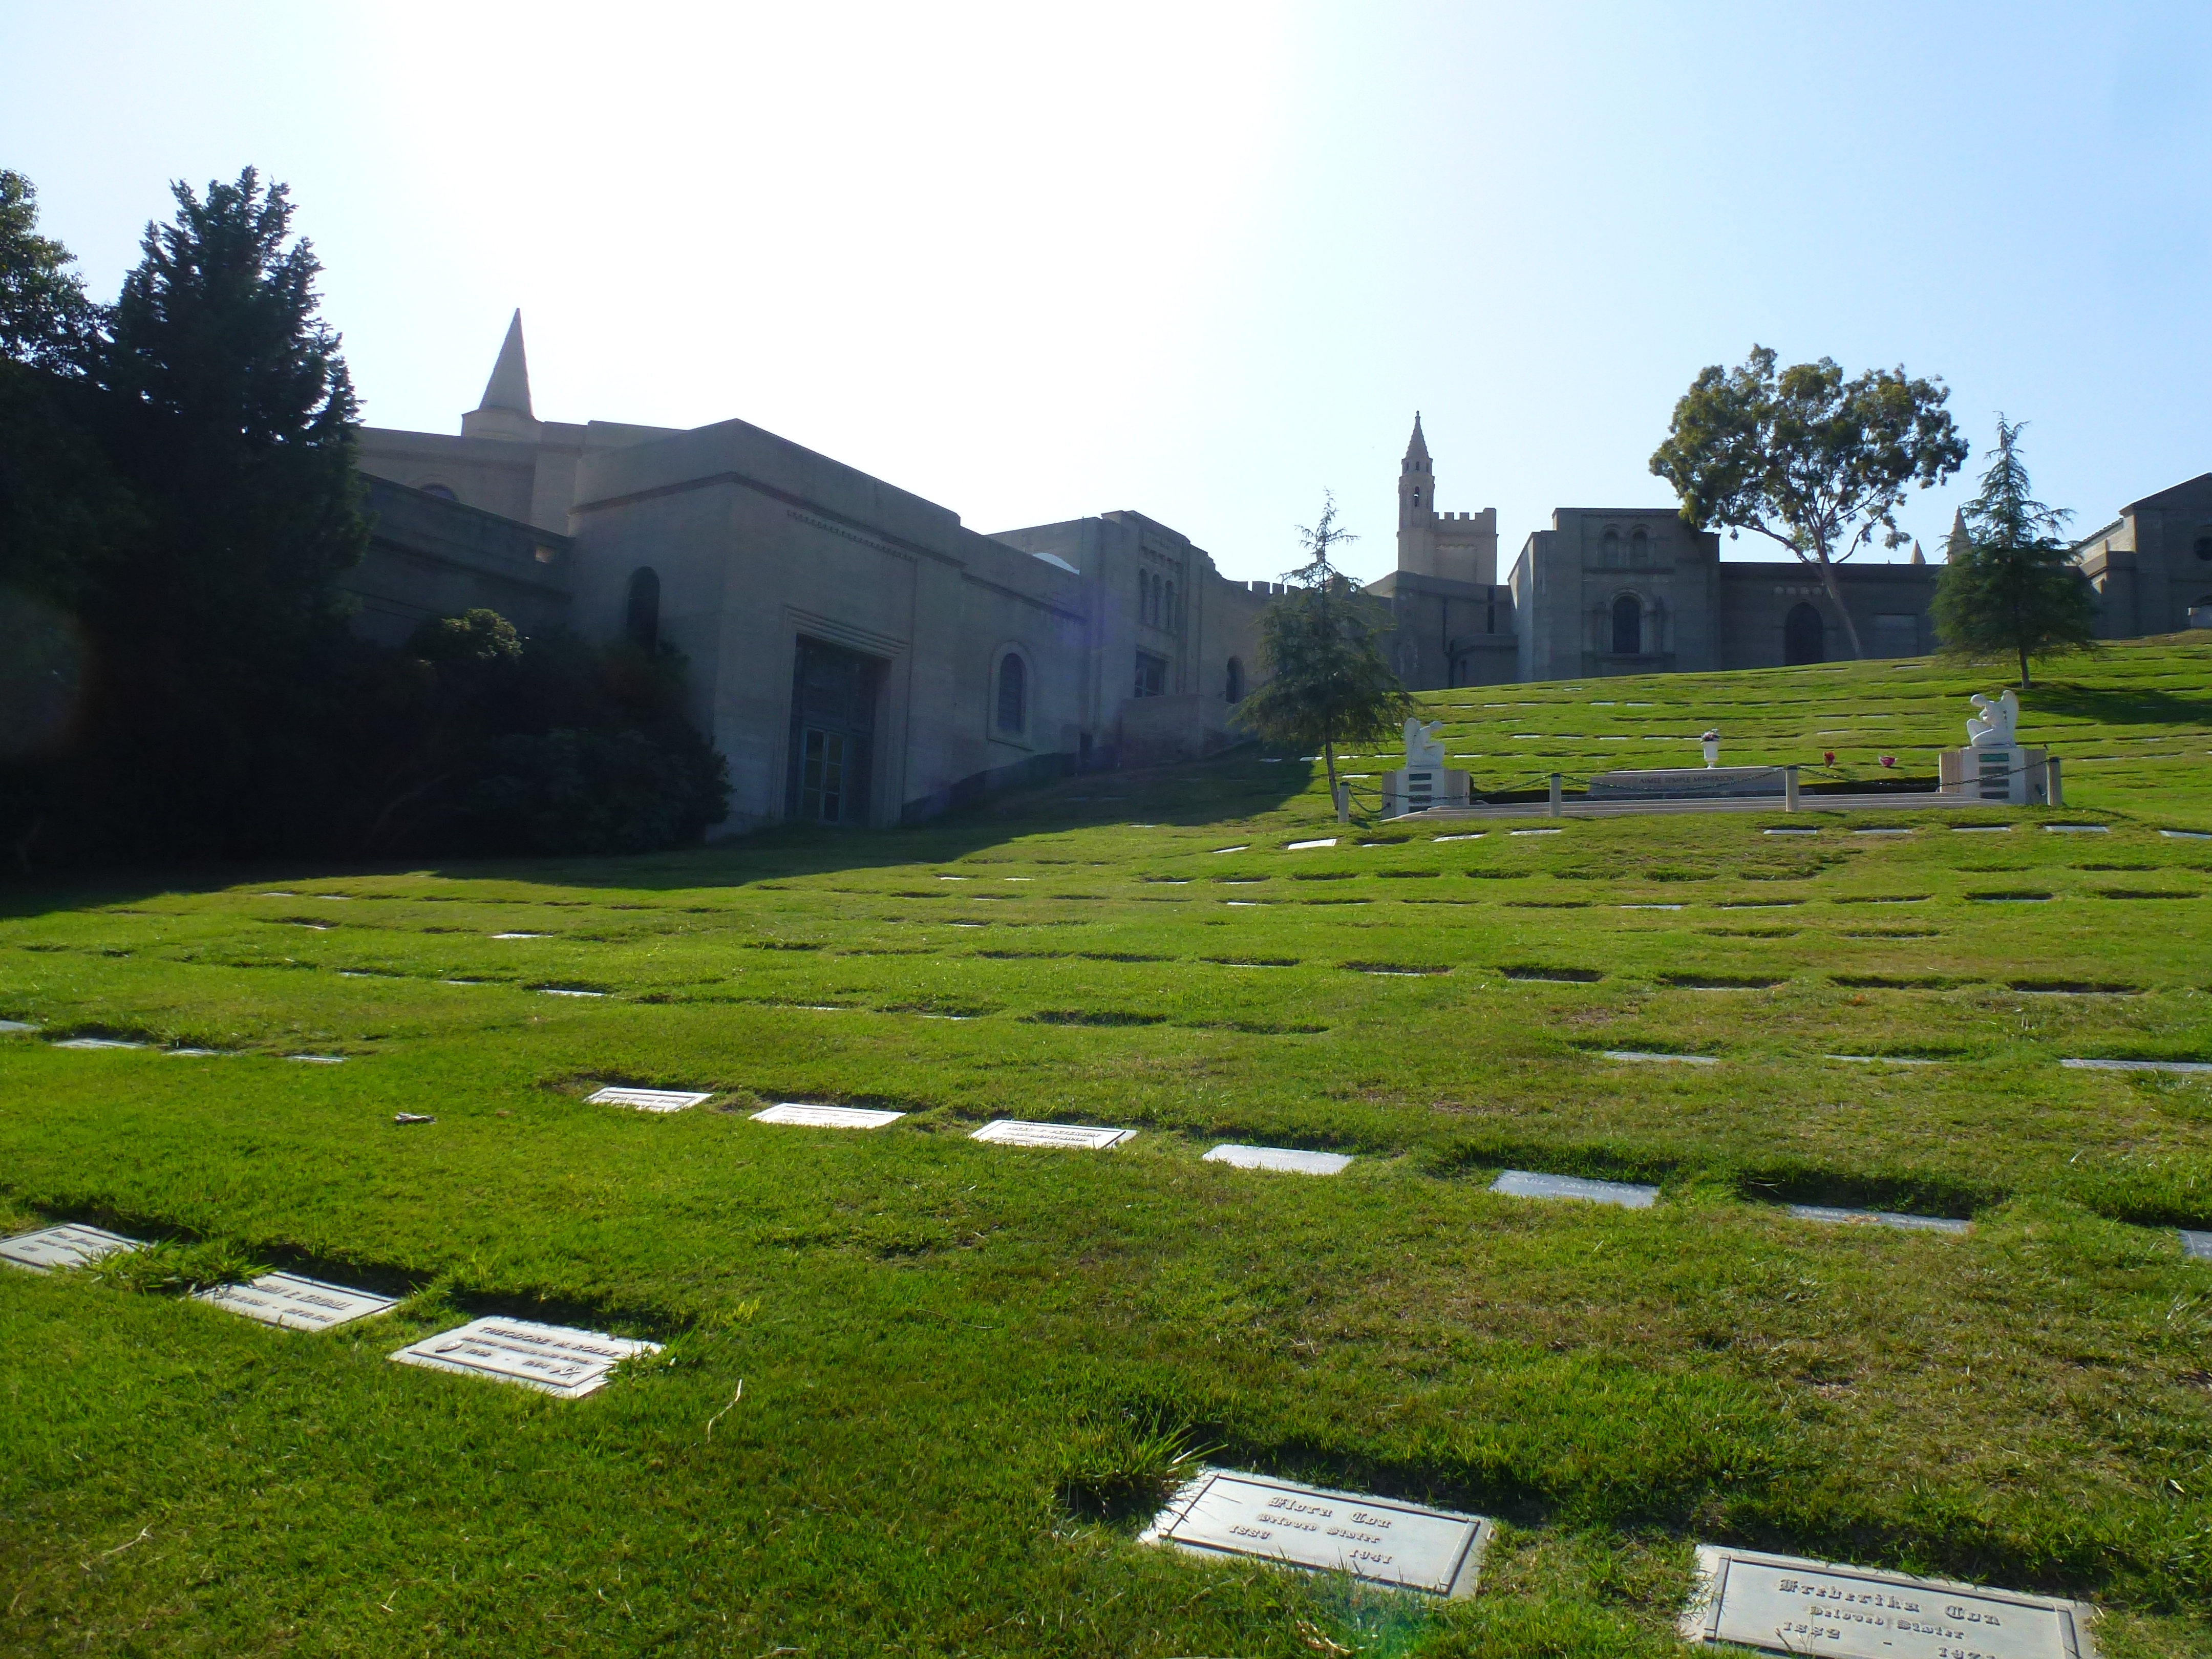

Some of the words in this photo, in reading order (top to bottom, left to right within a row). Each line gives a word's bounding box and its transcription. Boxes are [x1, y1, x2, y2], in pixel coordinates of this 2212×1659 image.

[479, 1327, 552, 1344] THEODORE
[461, 1336, 498, 1346] BELOVED
[500, 1345, 539, 1355] HUSBAND
[560, 1356, 594, 1366] FATHER
[1268, 1496, 1333, 1517] Flora
[1258, 1513, 1317, 1531] Beloved
[1326, 1526, 1380, 1543] Sister
[1779, 1579, 1920, 1612] Frederika
[1810, 1606, 1884, 1625] Beloved
[1897, 1619, 1965, 1640] Sister
